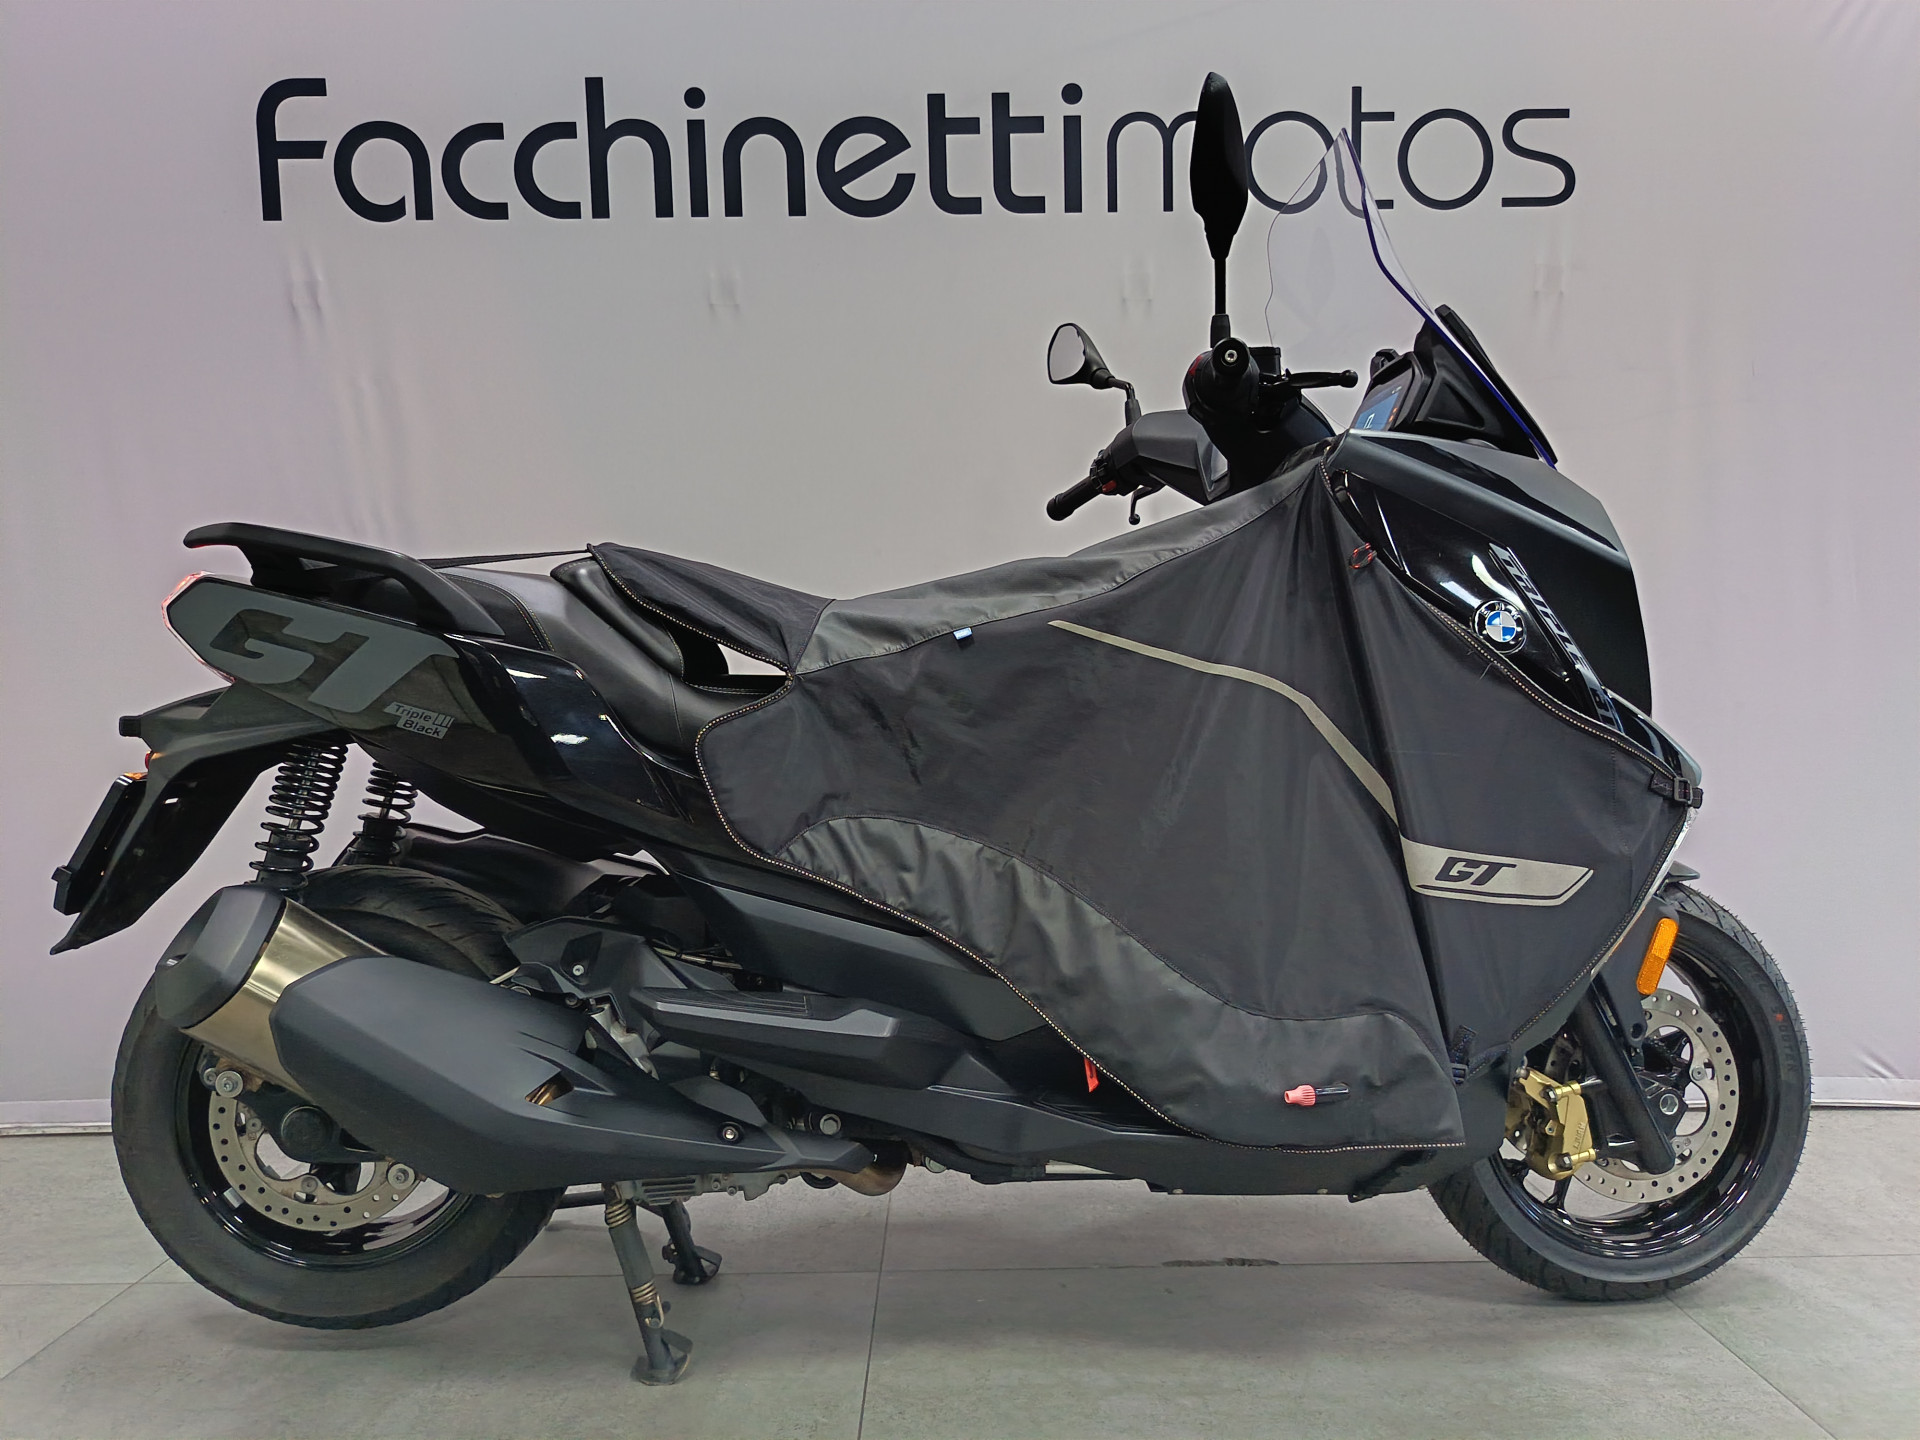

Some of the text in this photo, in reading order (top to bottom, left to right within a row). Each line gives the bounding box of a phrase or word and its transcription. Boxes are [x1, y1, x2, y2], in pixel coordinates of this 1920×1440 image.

[256, 77, 1576, 222] facchinettimotos
[167, 578, 460, 713] GT
[394, 704, 432, 722] Triple
[402, 719, 442, 737] Black
[1434, 856, 1517, 886] GT
